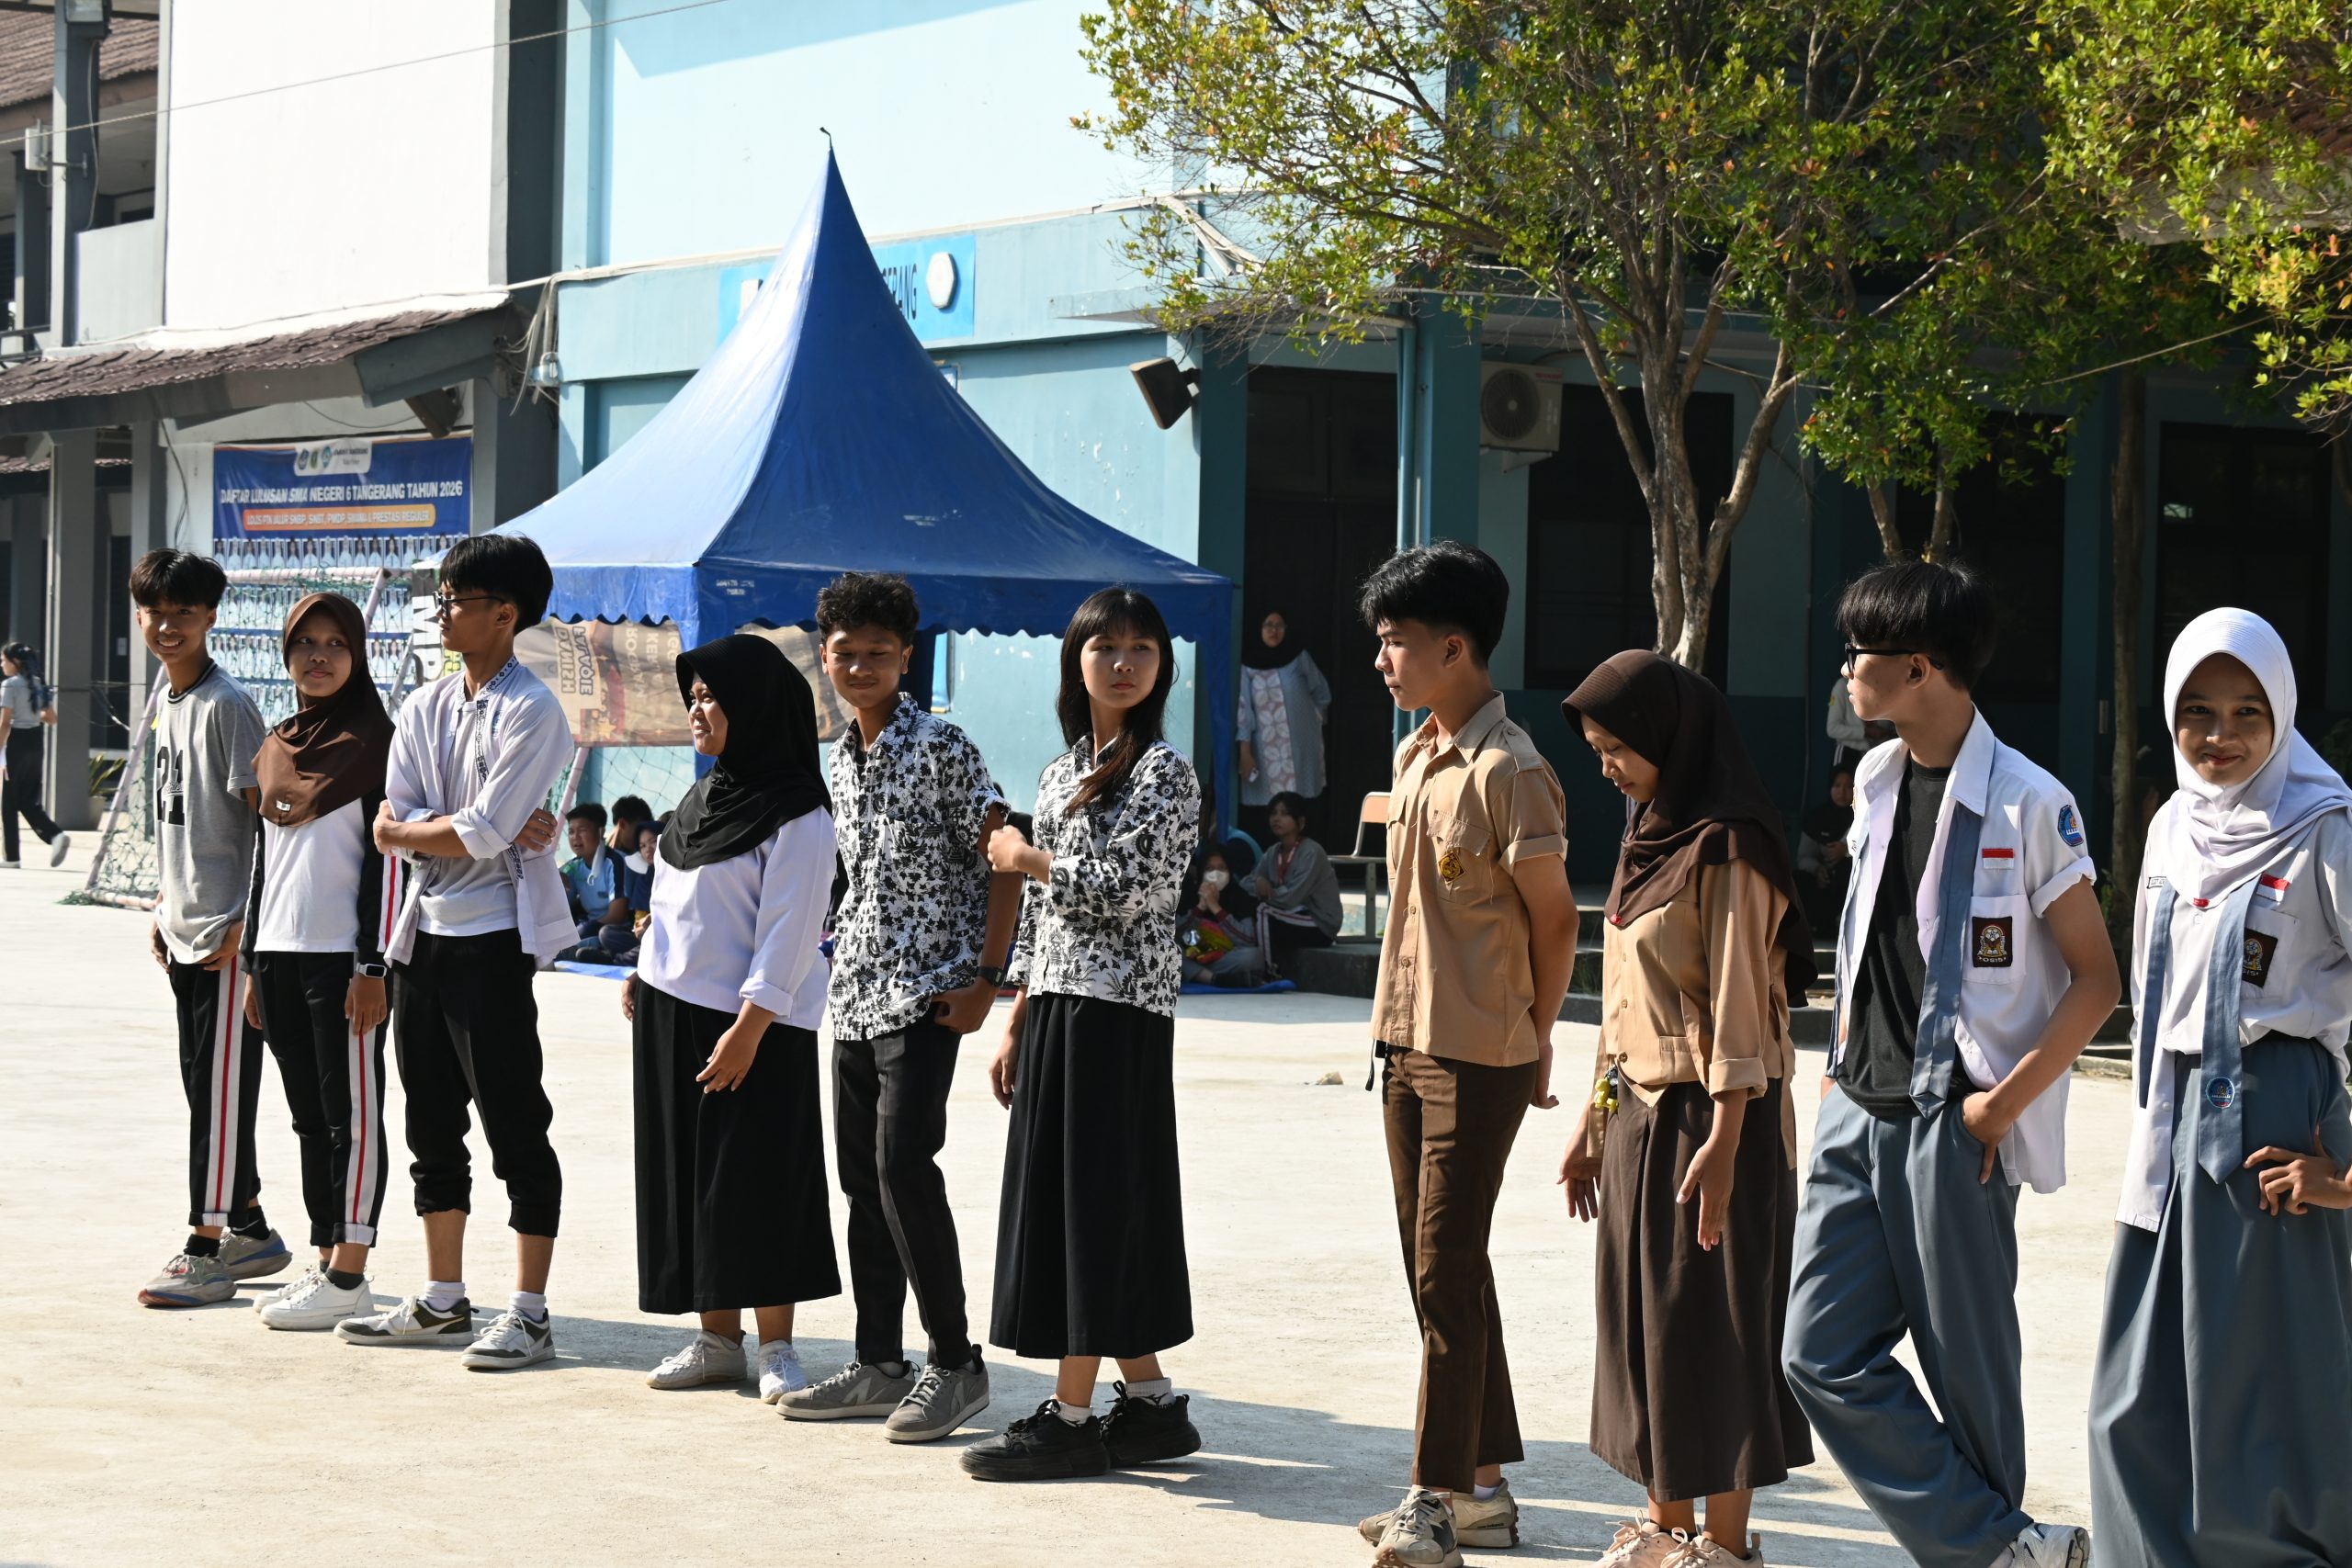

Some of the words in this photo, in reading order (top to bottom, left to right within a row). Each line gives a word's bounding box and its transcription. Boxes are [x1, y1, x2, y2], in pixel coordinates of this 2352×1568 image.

[220, 489, 250, 503] DAFTAR
[251, 488, 288, 503] LULUSAN
[288, 487, 308, 502] SMA
[310, 486, 345, 502] NEGERI
[345, 485, 352, 501] 6
[353, 483, 405, 501] TANGERANG
[407, 481, 438, 500] TAHUN
[439, 479, 463, 498] 2026
[372, 511, 402, 523] PRESTASI
[402, 510, 430, 522] REGULER
